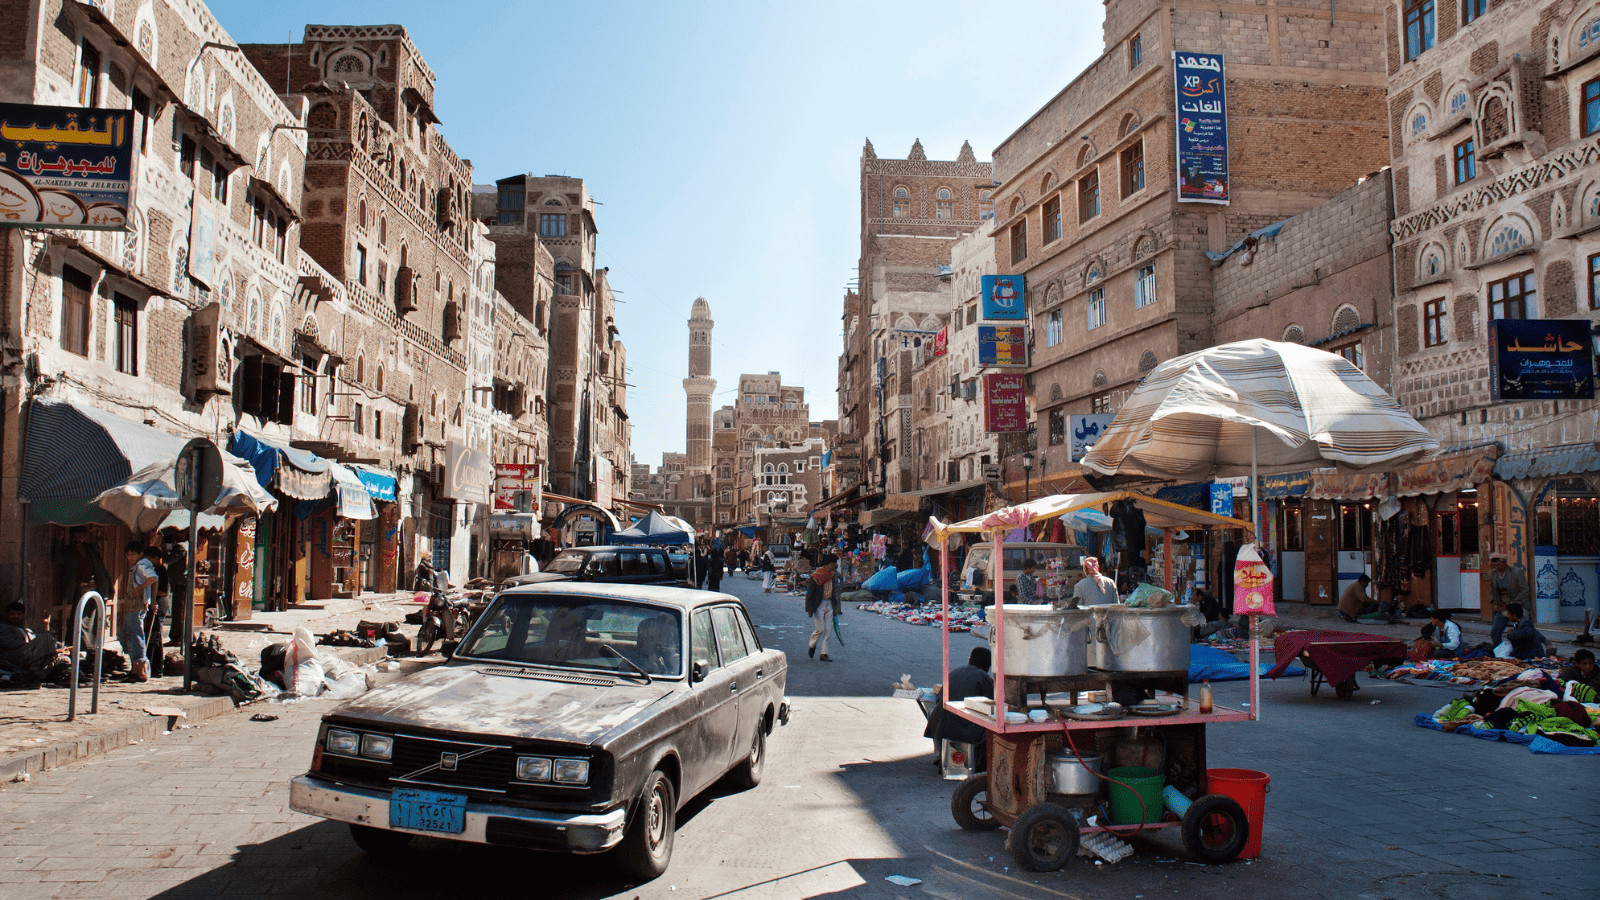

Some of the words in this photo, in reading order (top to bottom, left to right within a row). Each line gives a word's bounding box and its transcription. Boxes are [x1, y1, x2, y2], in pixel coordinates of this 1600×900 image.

[1178, 55, 1221, 73] معهد
[1184, 75, 1199, 87] XP
[1181, 99, 1222, 114] للغات
[0, 111, 126, 151] النقيب
[17, 151, 117, 178] للمجوهرات
[73, 180, 88, 188] FOR
[1507, 332, 1583, 353] حاشد
[1520, 359, 1573, 368] للمجوهرات
[419, 818, 451, 830] 32521
